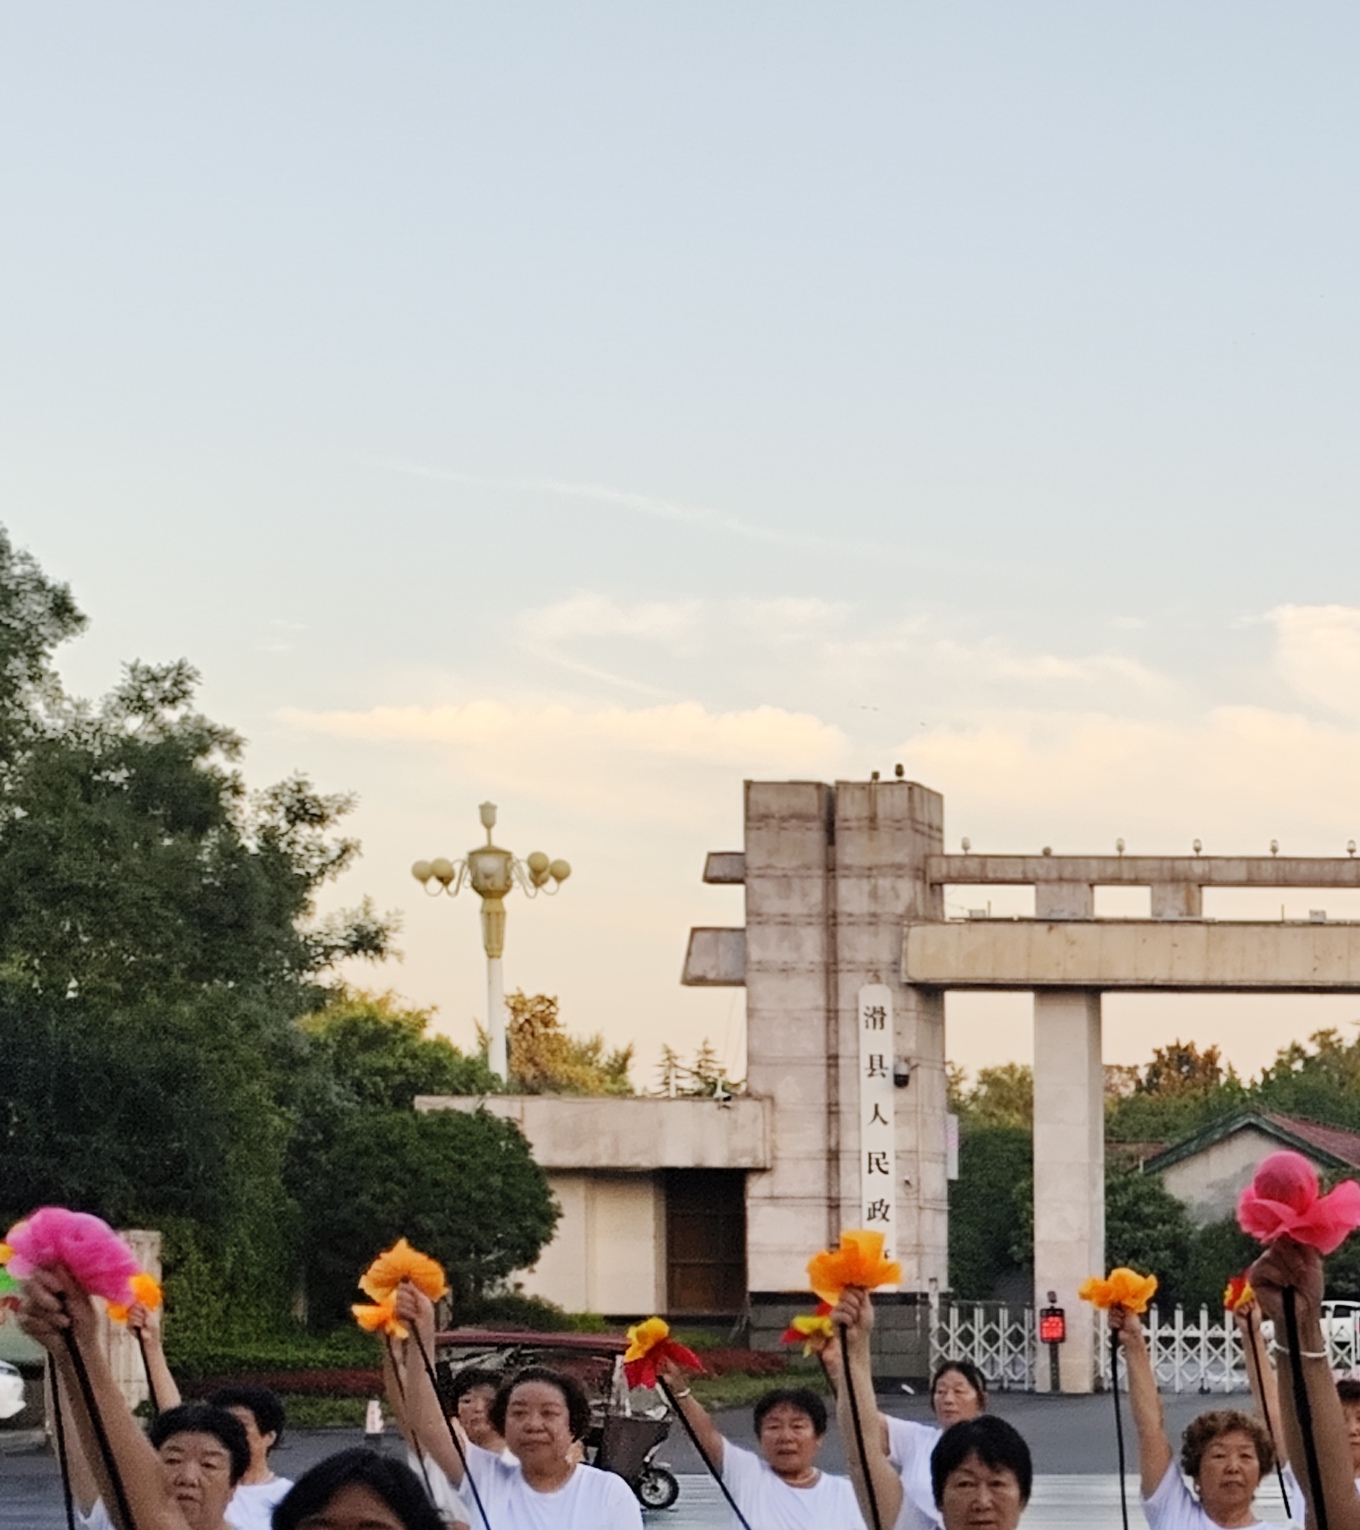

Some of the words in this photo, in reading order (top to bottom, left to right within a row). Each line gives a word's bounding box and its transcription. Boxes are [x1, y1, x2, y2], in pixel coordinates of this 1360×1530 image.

[863, 1005, 890, 1260] 滑县人民政
